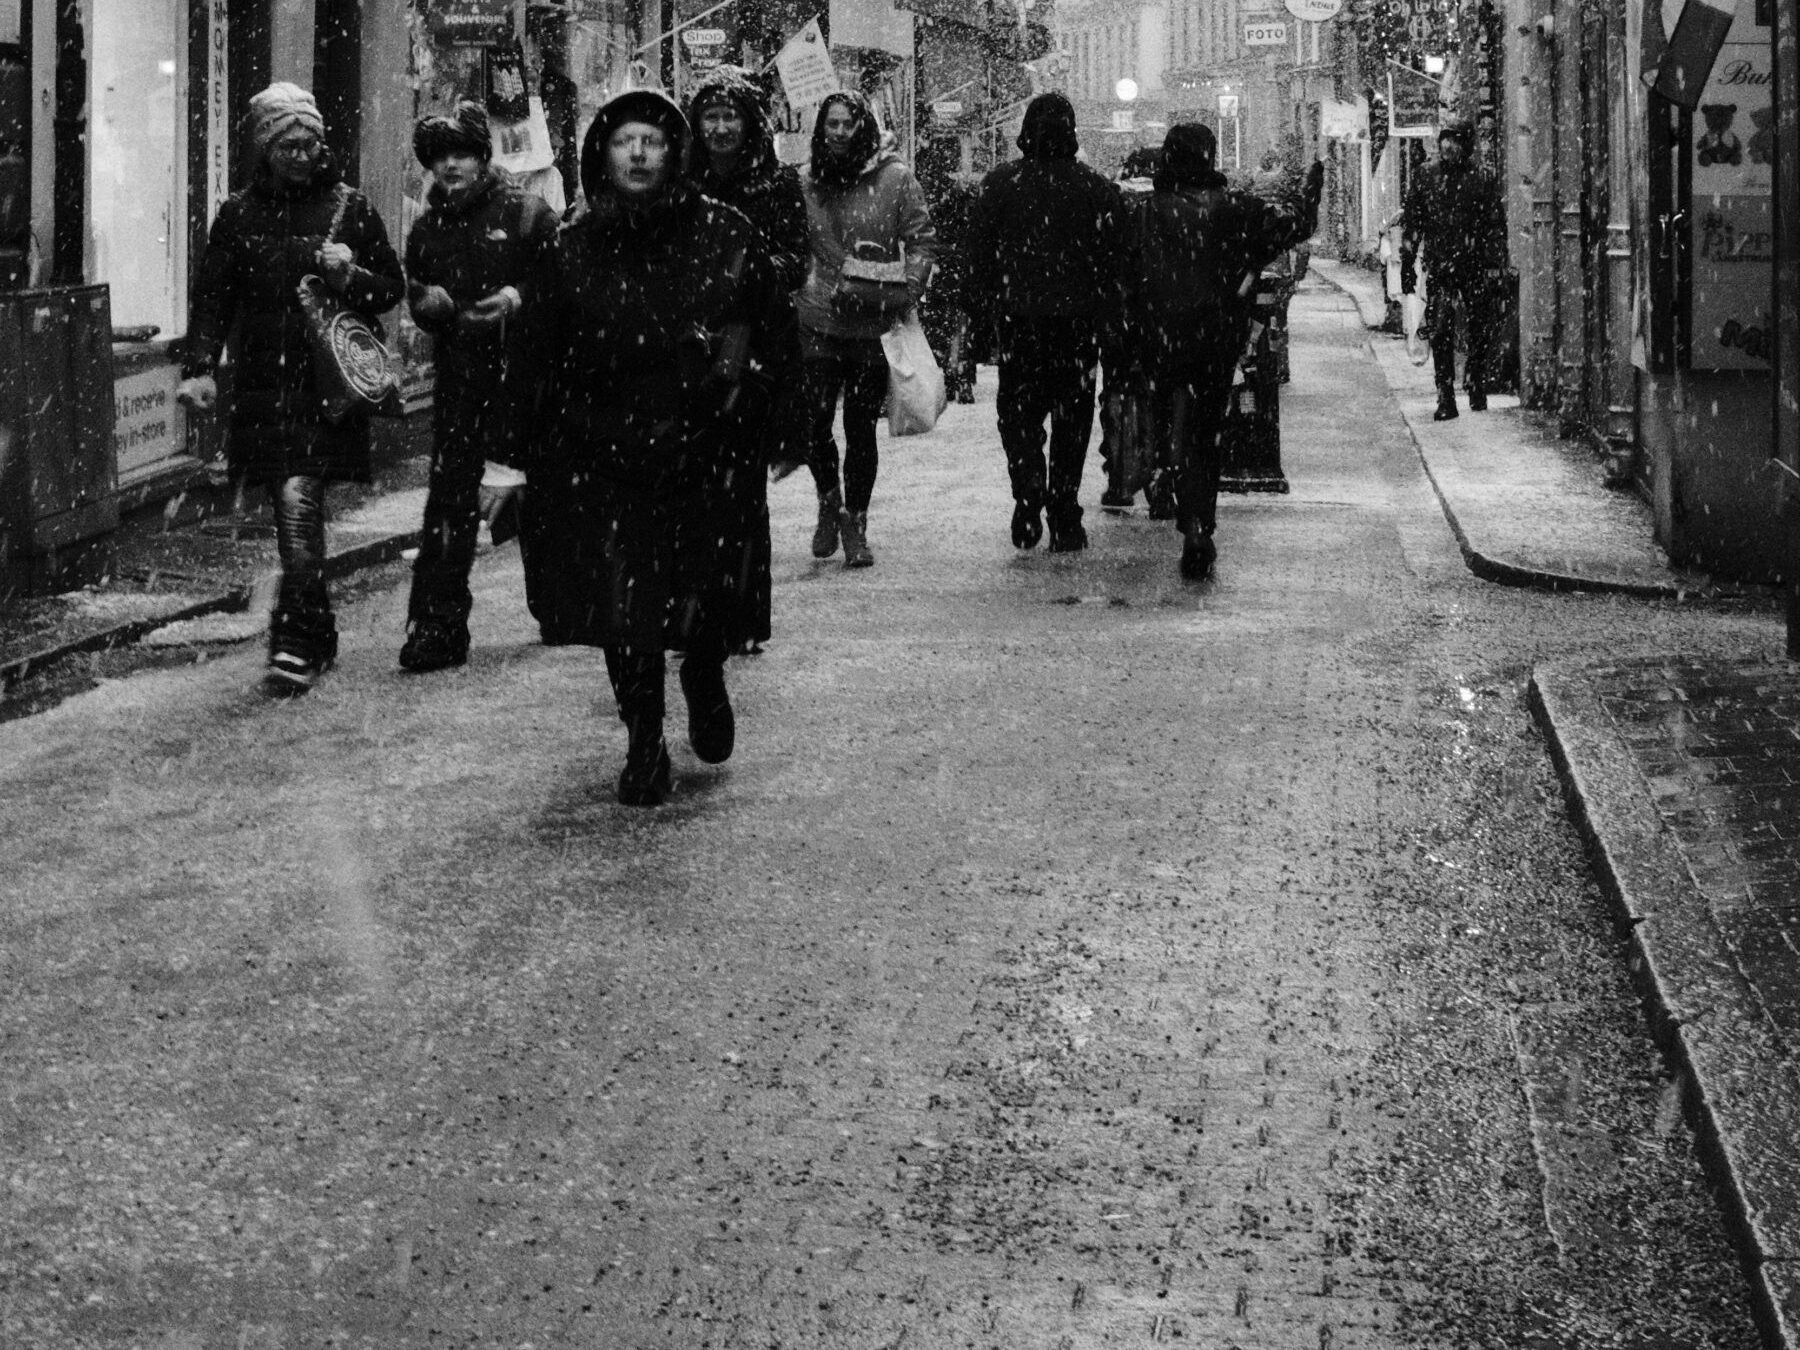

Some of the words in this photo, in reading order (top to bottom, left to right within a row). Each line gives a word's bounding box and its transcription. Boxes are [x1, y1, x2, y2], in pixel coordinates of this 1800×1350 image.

[444, 14, 507, 25] SOUVENIRS
[686, 30, 724, 44] Shop
[1246, 29, 1284, 41] FOTO
